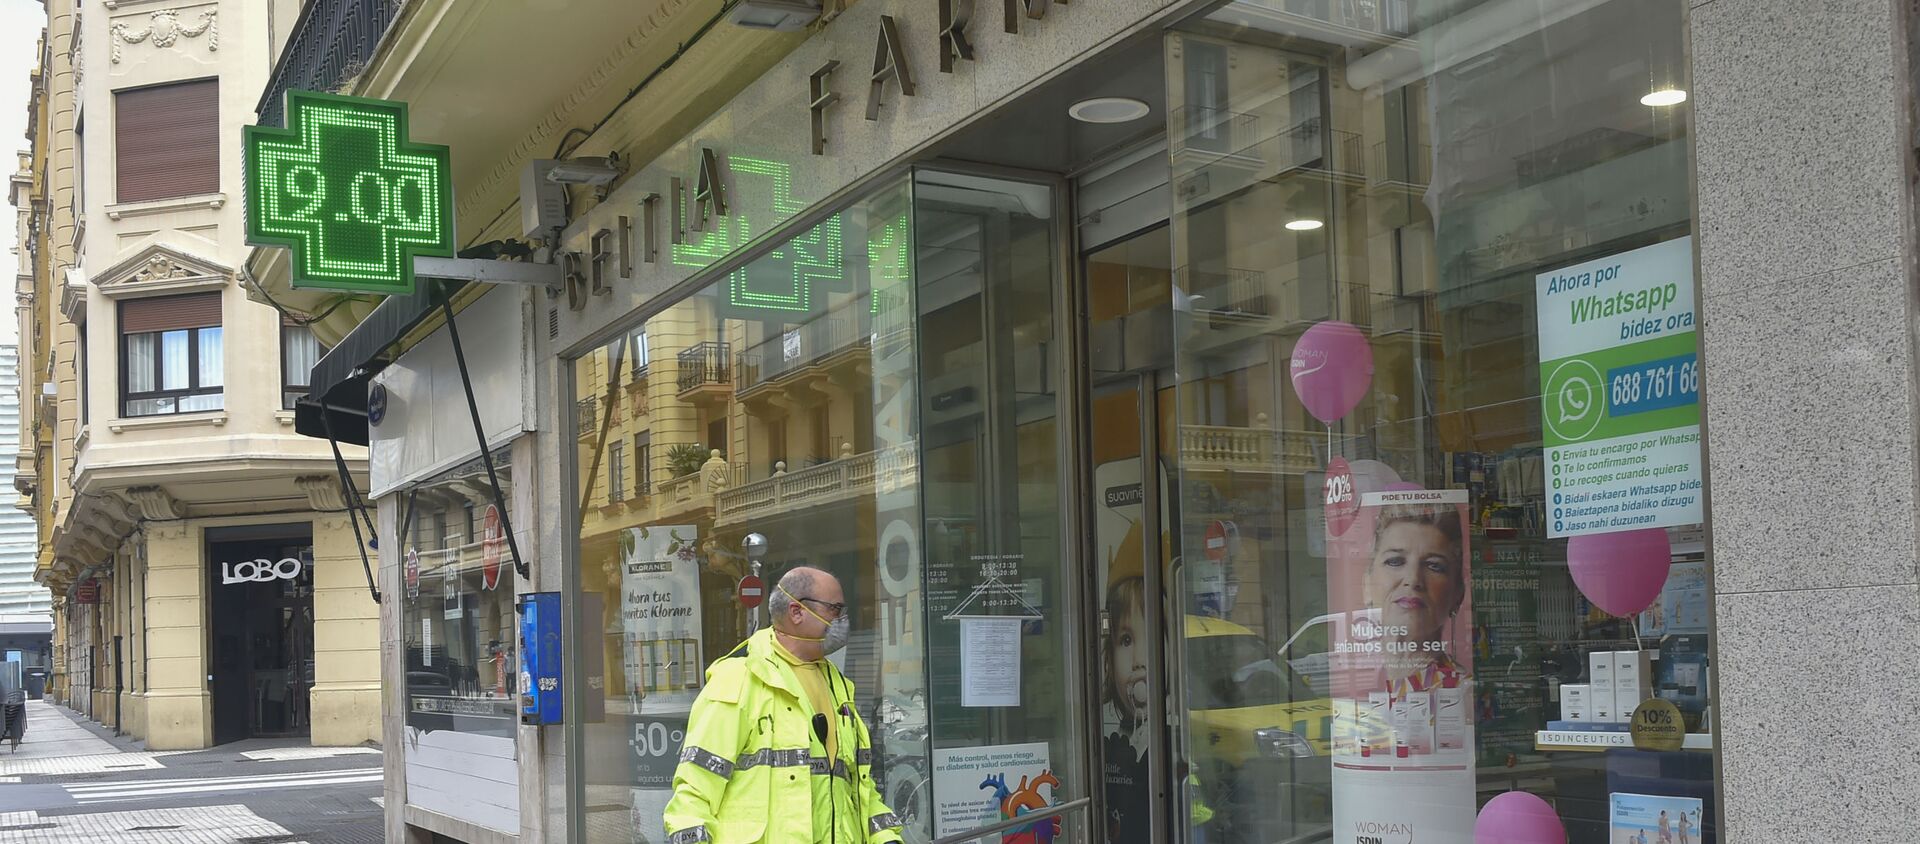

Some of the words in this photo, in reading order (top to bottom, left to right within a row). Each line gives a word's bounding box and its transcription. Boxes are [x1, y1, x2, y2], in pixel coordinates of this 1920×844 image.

[564, 148, 727, 311] BEITIA
[1546, 272, 1590, 296] Ahora
[1594, 264, 1621, 288] por
[1570, 282, 1677, 325] Whatsapp
[1620, 317, 1662, 340] bidez
[1612, 371, 1641, 406] 688
[1646, 364, 1674, 400] 761
[1589, 448, 1599, 457] tu
[1600, 441, 1638, 455] encargo
[1640, 438, 1657, 452] por
[1563, 463, 1574, 474] Te
[1576, 462, 1585, 472] lo
[1586, 454, 1647, 471] confirmamos
[1564, 477, 1575, 487] Lo
[1577, 472, 1613, 487] recoges
[1615, 468, 1650, 481] cuando
[1652, 463, 1689, 476] quieras
[1326, 474, 1351, 504] 20%
[1415, 492, 1442, 500] BOLSA
[1564, 492, 1590, 505] Bidali
[1591, 488, 1627, 501] eskaera
[1629, 483, 1677, 498] Whatsapp
[1679, 479, 1703, 491] bide
[1565, 504, 1619, 518] Baieztapena
[1621, 498, 1659, 512] bidaliko
[1661, 495, 1695, 508] dizugu
[1565, 520, 1587, 531] Jaso
[1588, 517, 1609, 529] nahi
[1610, 514, 1656, 527] duzunean
[222, 558, 301, 584] LOBO
[652, 590, 672, 603] tus
[651, 603, 693, 618] Klorane
[1351, 623, 1408, 639] Mujeres
[1386, 641, 1418, 655] que
[1422, 640, 1448, 652] ser
[1641, 709, 1672, 724] 10%
[1637, 724, 1677, 733] Descuento
[1543, 733, 1625, 744] ISDINCEUTICS
[946, 762, 974, 771] diabetes
[976, 763, 981, 771] y
[981, 760, 999, 769] salud
[1000, 758, 1047, 768] cardiovascular
[948, 754, 963, 763] Más
[991, 753, 1013, 761] menos
[1014, 751, 1033, 761] riesgo
[1355, 821, 1413, 835] WOMAN
